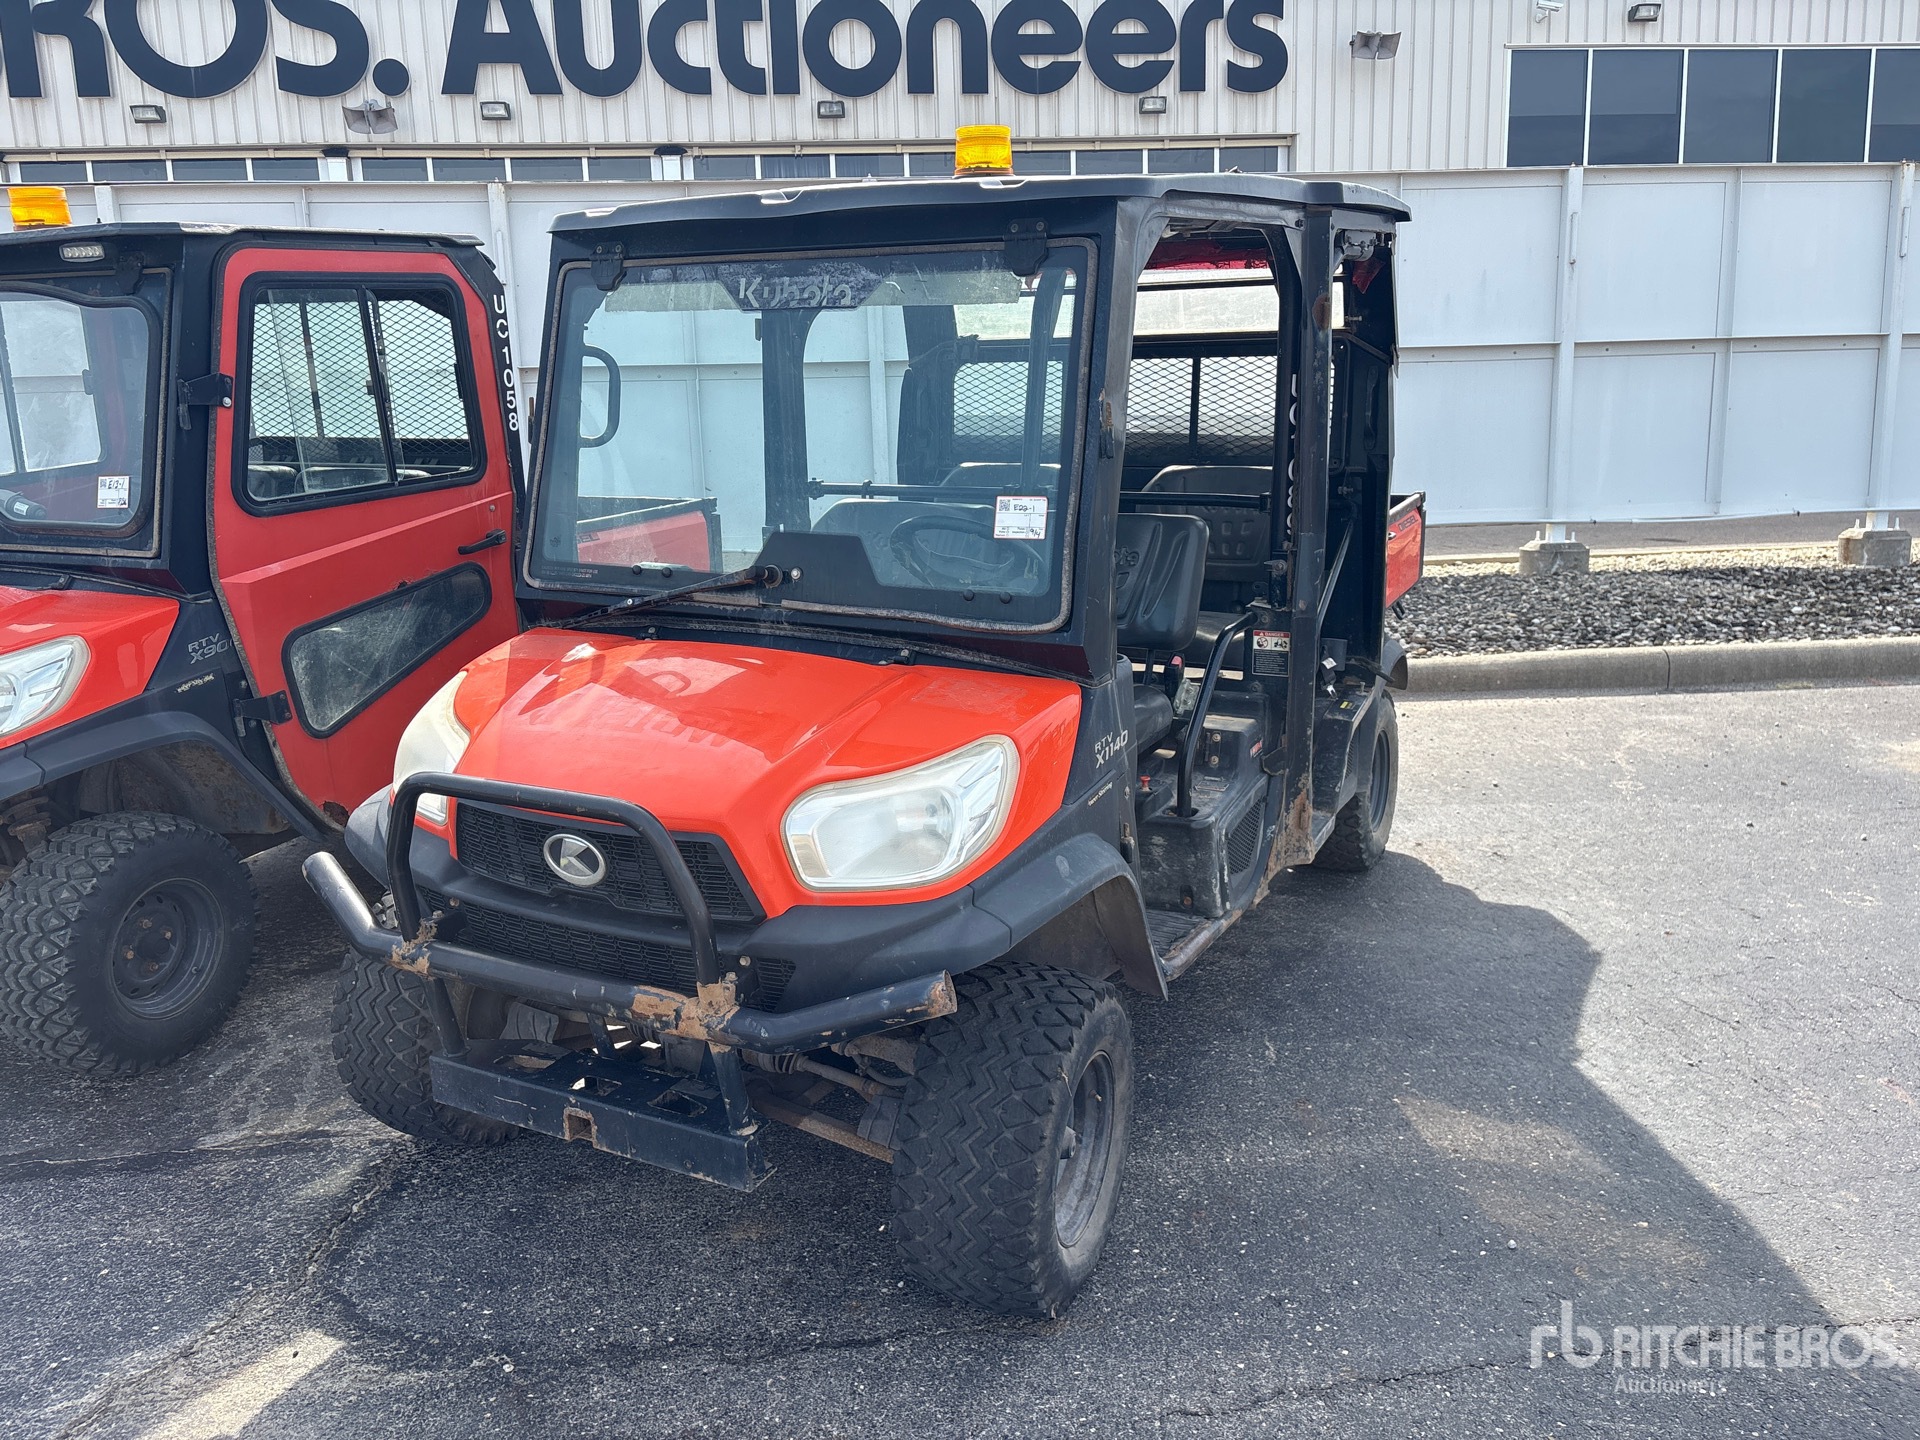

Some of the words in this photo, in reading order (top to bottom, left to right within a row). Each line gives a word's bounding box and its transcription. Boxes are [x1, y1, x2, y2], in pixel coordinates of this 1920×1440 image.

[441, 0, 1288, 97] Auctioneers
[187, 632, 220, 653] RTV
[190, 639, 234, 665] X90
[1094, 731, 1113, 754] RTV
[1095, 729, 1129, 769] X1140
